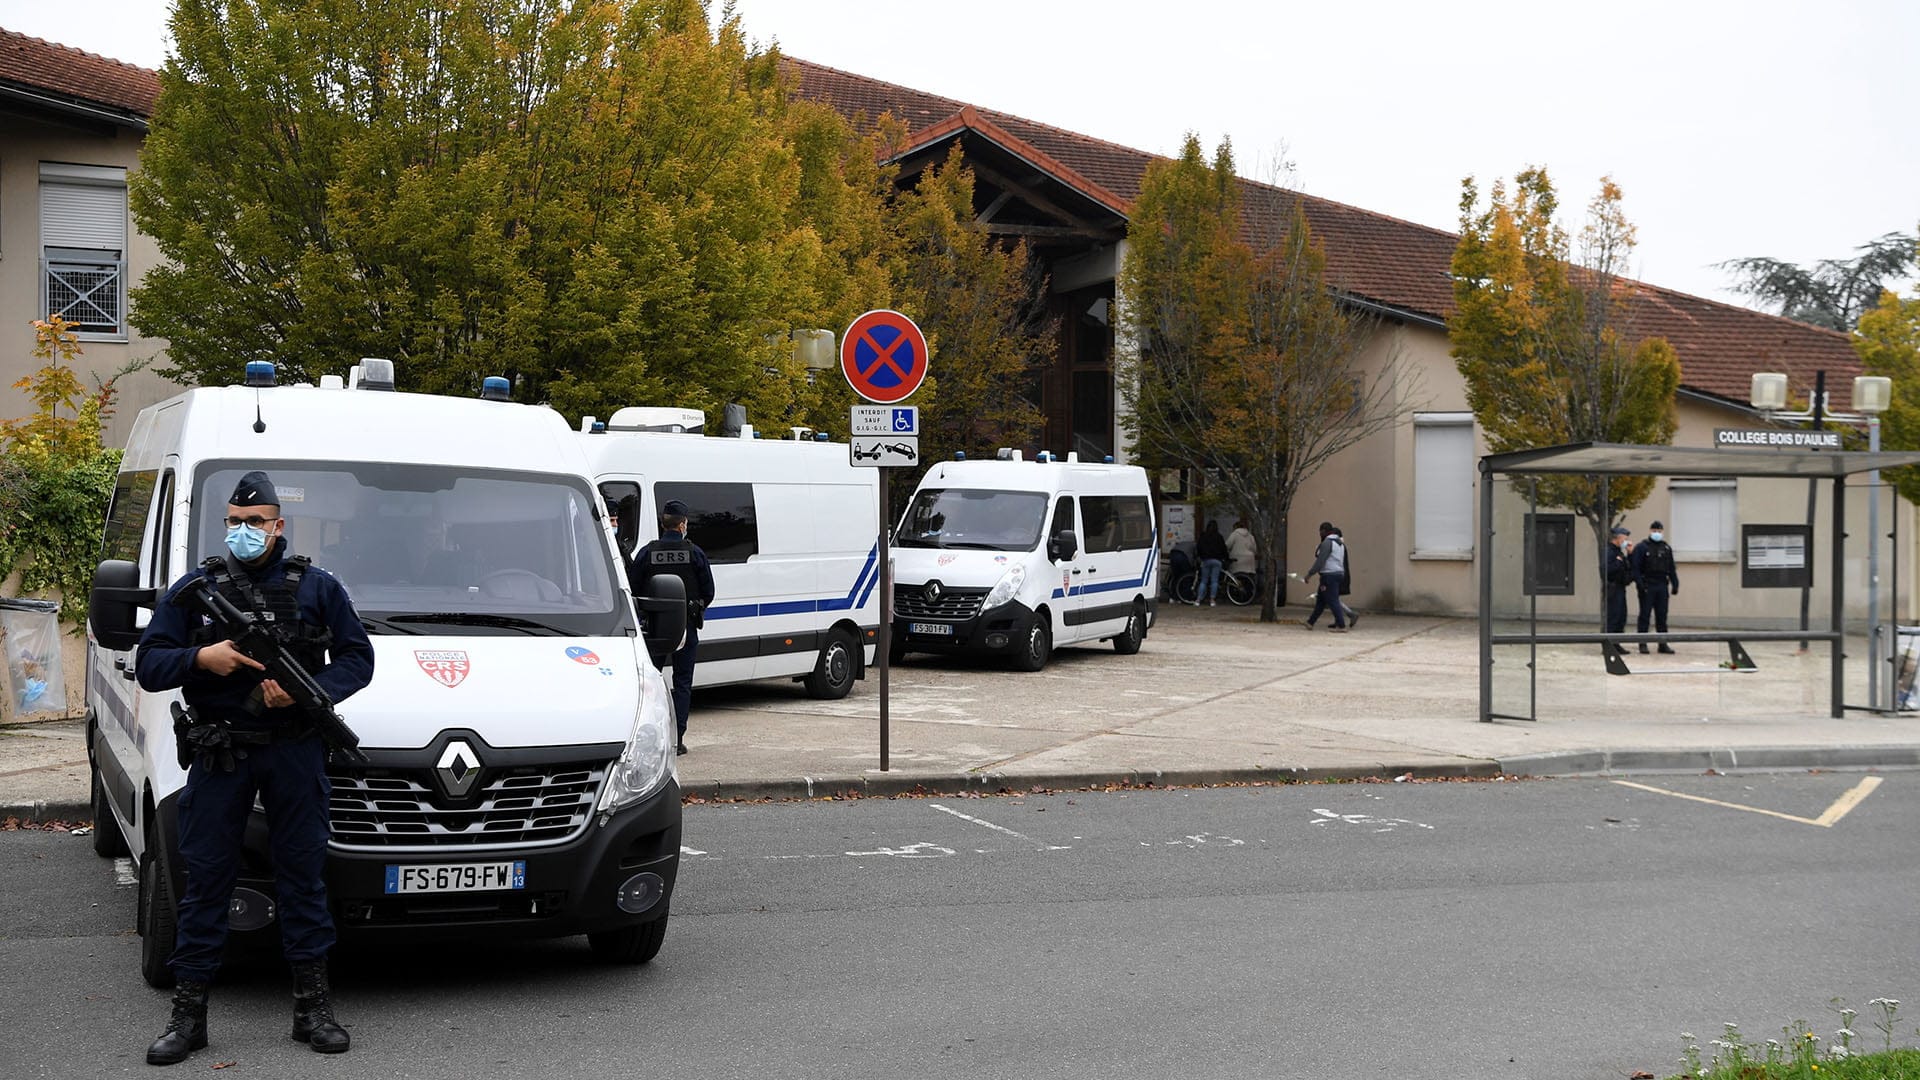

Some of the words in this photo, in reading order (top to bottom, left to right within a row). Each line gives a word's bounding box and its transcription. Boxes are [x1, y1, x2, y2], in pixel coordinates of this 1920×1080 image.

[1719, 431, 1767, 444] COLLEGE
[1769, 433, 1793, 445] BOIS
[1795, 433, 1838, 446] D'AULNE
[656, 552, 685, 562] CRS
[421, 661, 468, 670] CRS
[403, 865, 508, 890] FS-679-FW
[513, 875, 524, 887] 13
